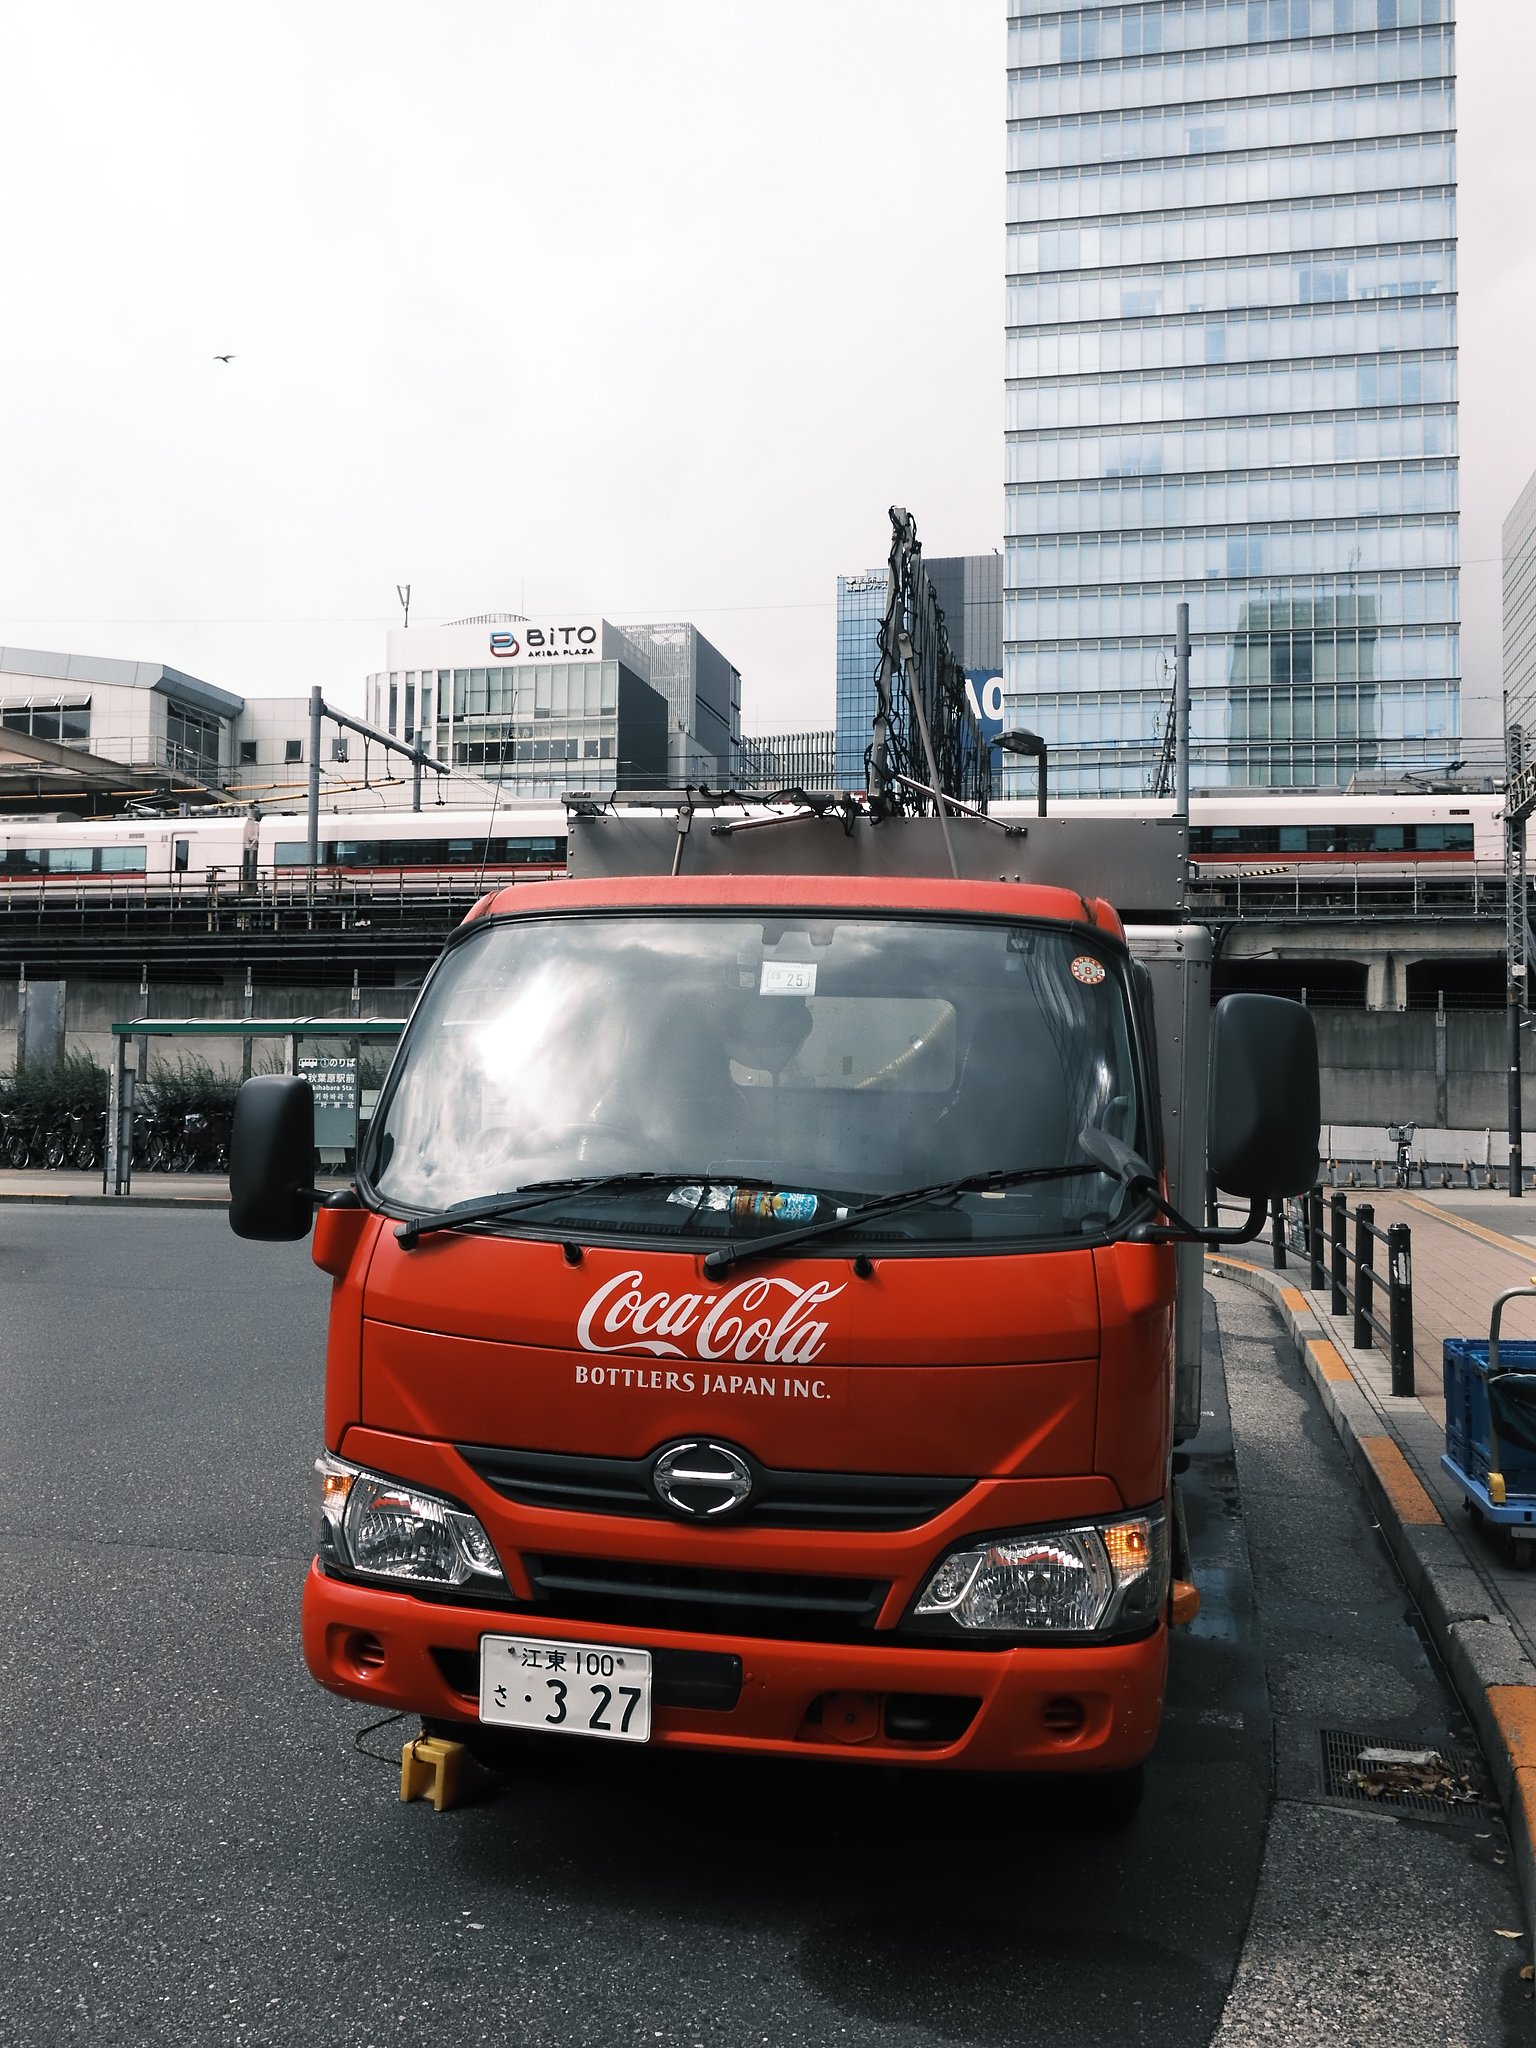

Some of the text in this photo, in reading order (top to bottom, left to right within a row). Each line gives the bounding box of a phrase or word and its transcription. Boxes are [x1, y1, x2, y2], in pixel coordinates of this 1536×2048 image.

[787, 973, 803, 987] 25
[307, 1073, 355, 1083] 秋葉原駅前
[577, 1270, 848, 1364] Coca-Cola
[575, 1366, 831, 1399] BOTTLERS JAPAN INC.
[521, 1647, 614, 1677] 江東 100
[493, 1684, 507, 1708] さ
